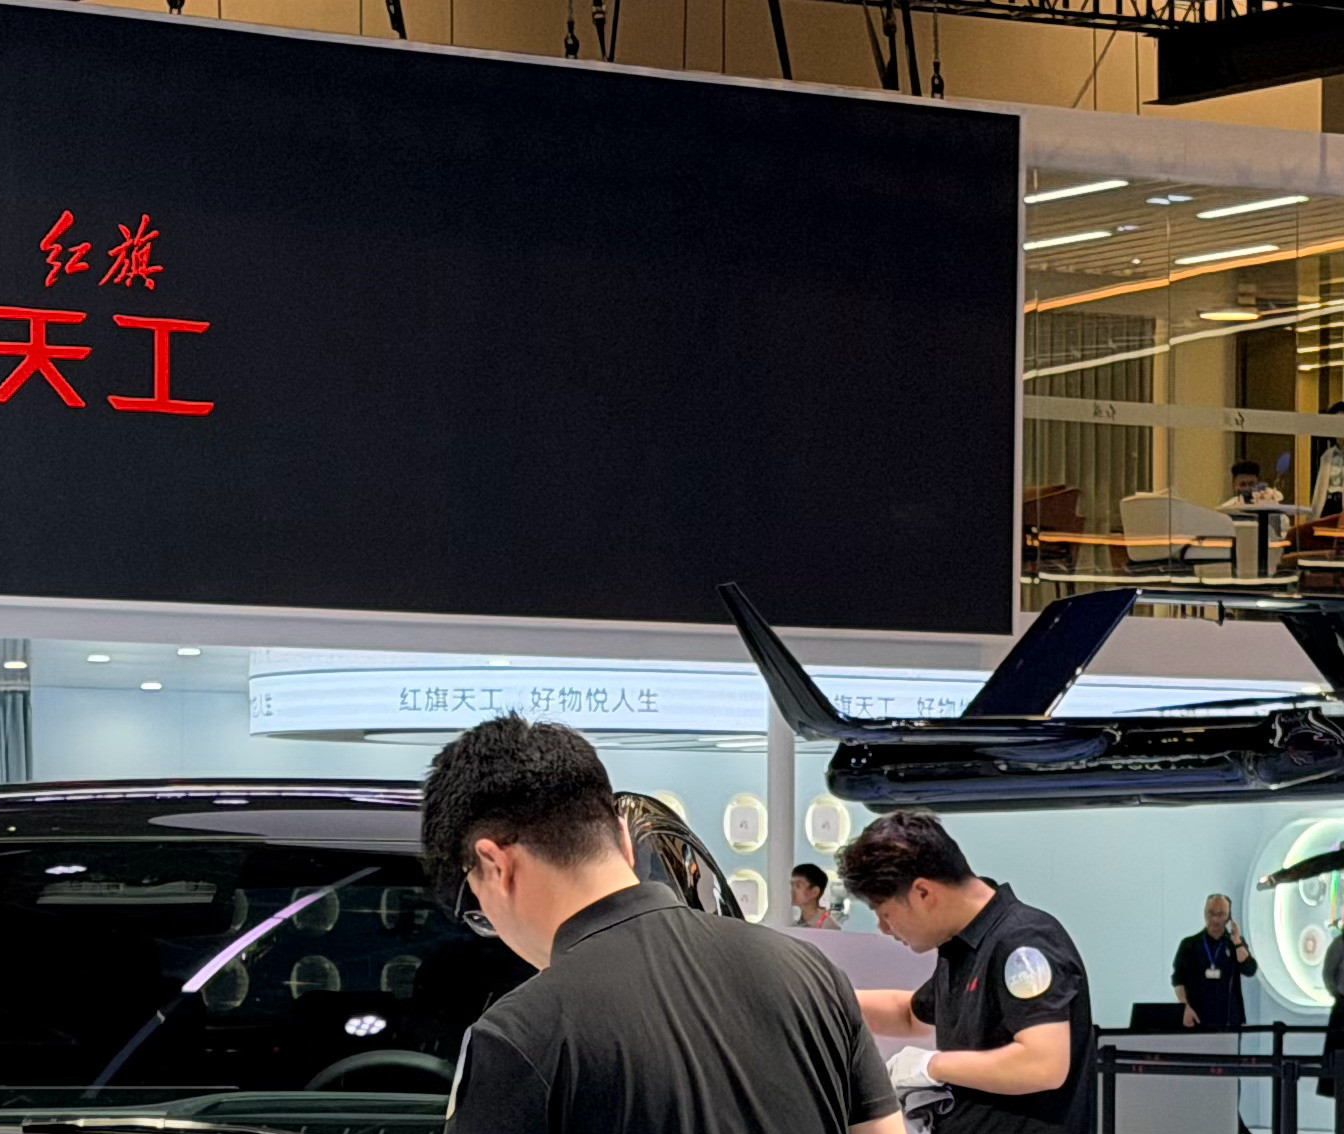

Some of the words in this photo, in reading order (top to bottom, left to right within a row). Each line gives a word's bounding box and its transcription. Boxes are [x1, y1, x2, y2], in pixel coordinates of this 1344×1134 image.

[40, 210, 164, 290] 红旗
[398, 686, 504, 712] 红旗天工
[530, 686, 660, 713] 好物悦人生
[917, 696, 966, 718] 好物
